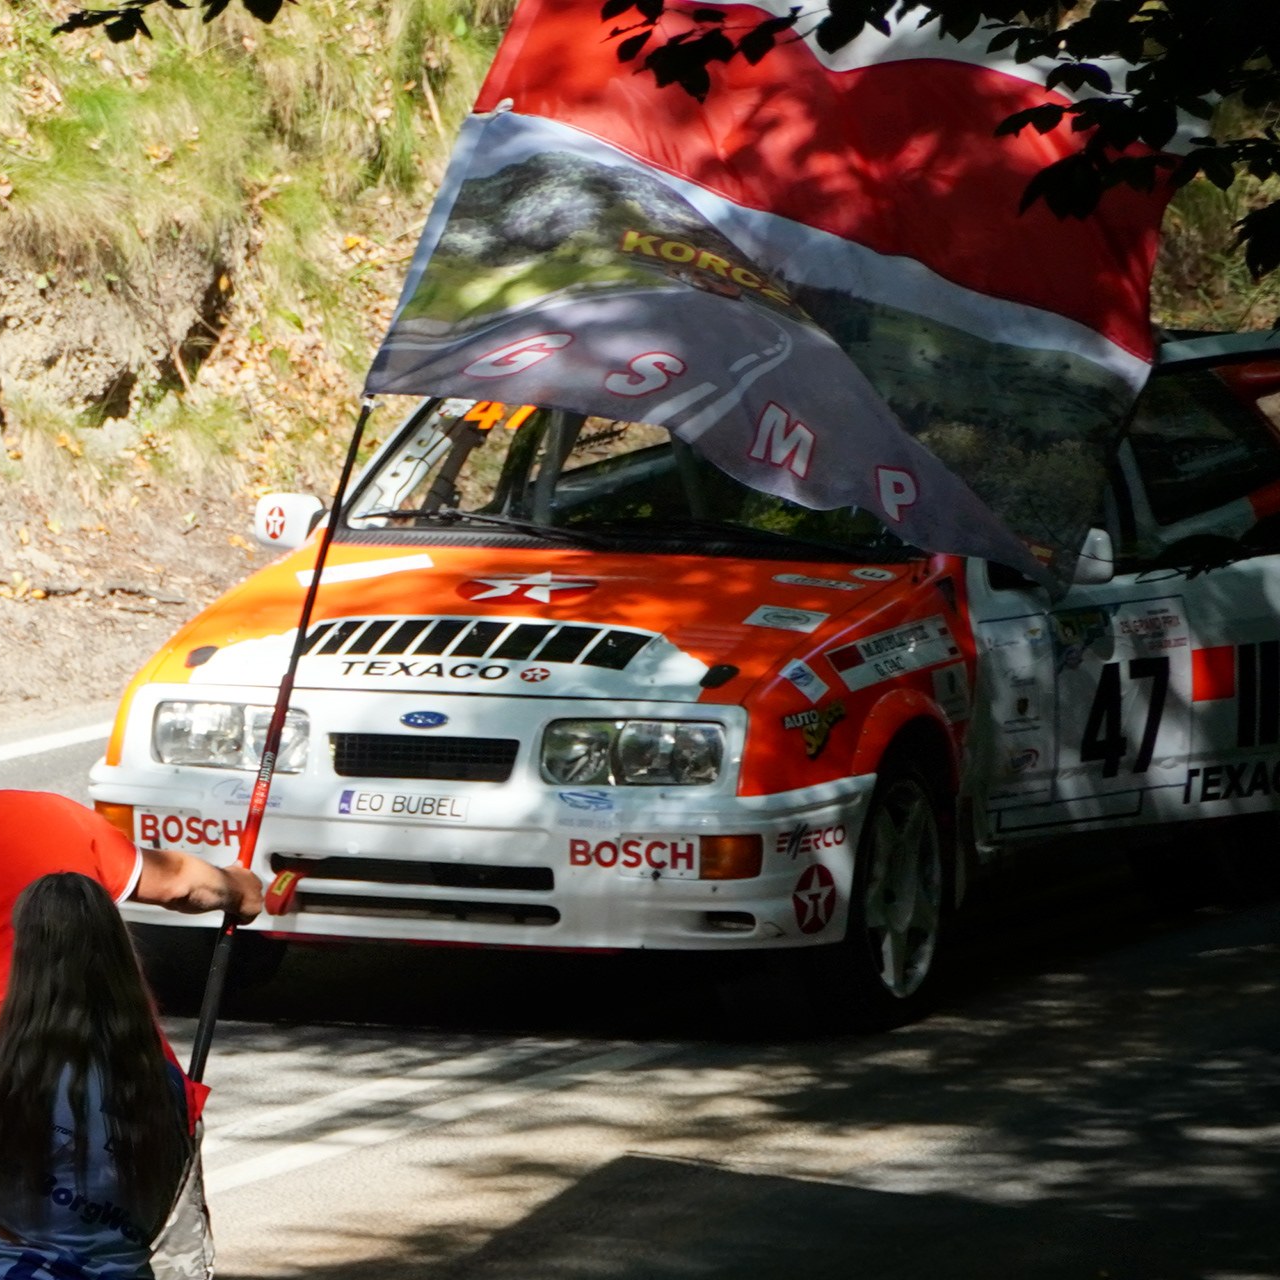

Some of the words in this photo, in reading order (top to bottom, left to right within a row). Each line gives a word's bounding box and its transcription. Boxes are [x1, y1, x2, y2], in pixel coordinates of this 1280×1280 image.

[341, 659, 508, 681] TEXACO
[784, 708, 819, 730] AUTO
[1081, 656, 1170, 778] 47
[356, 793, 384, 812] EO
[391, 795, 463, 818] BUBEL
[140, 812, 243, 848] BOSCH
[569, 838, 694, 871] BOSCH
